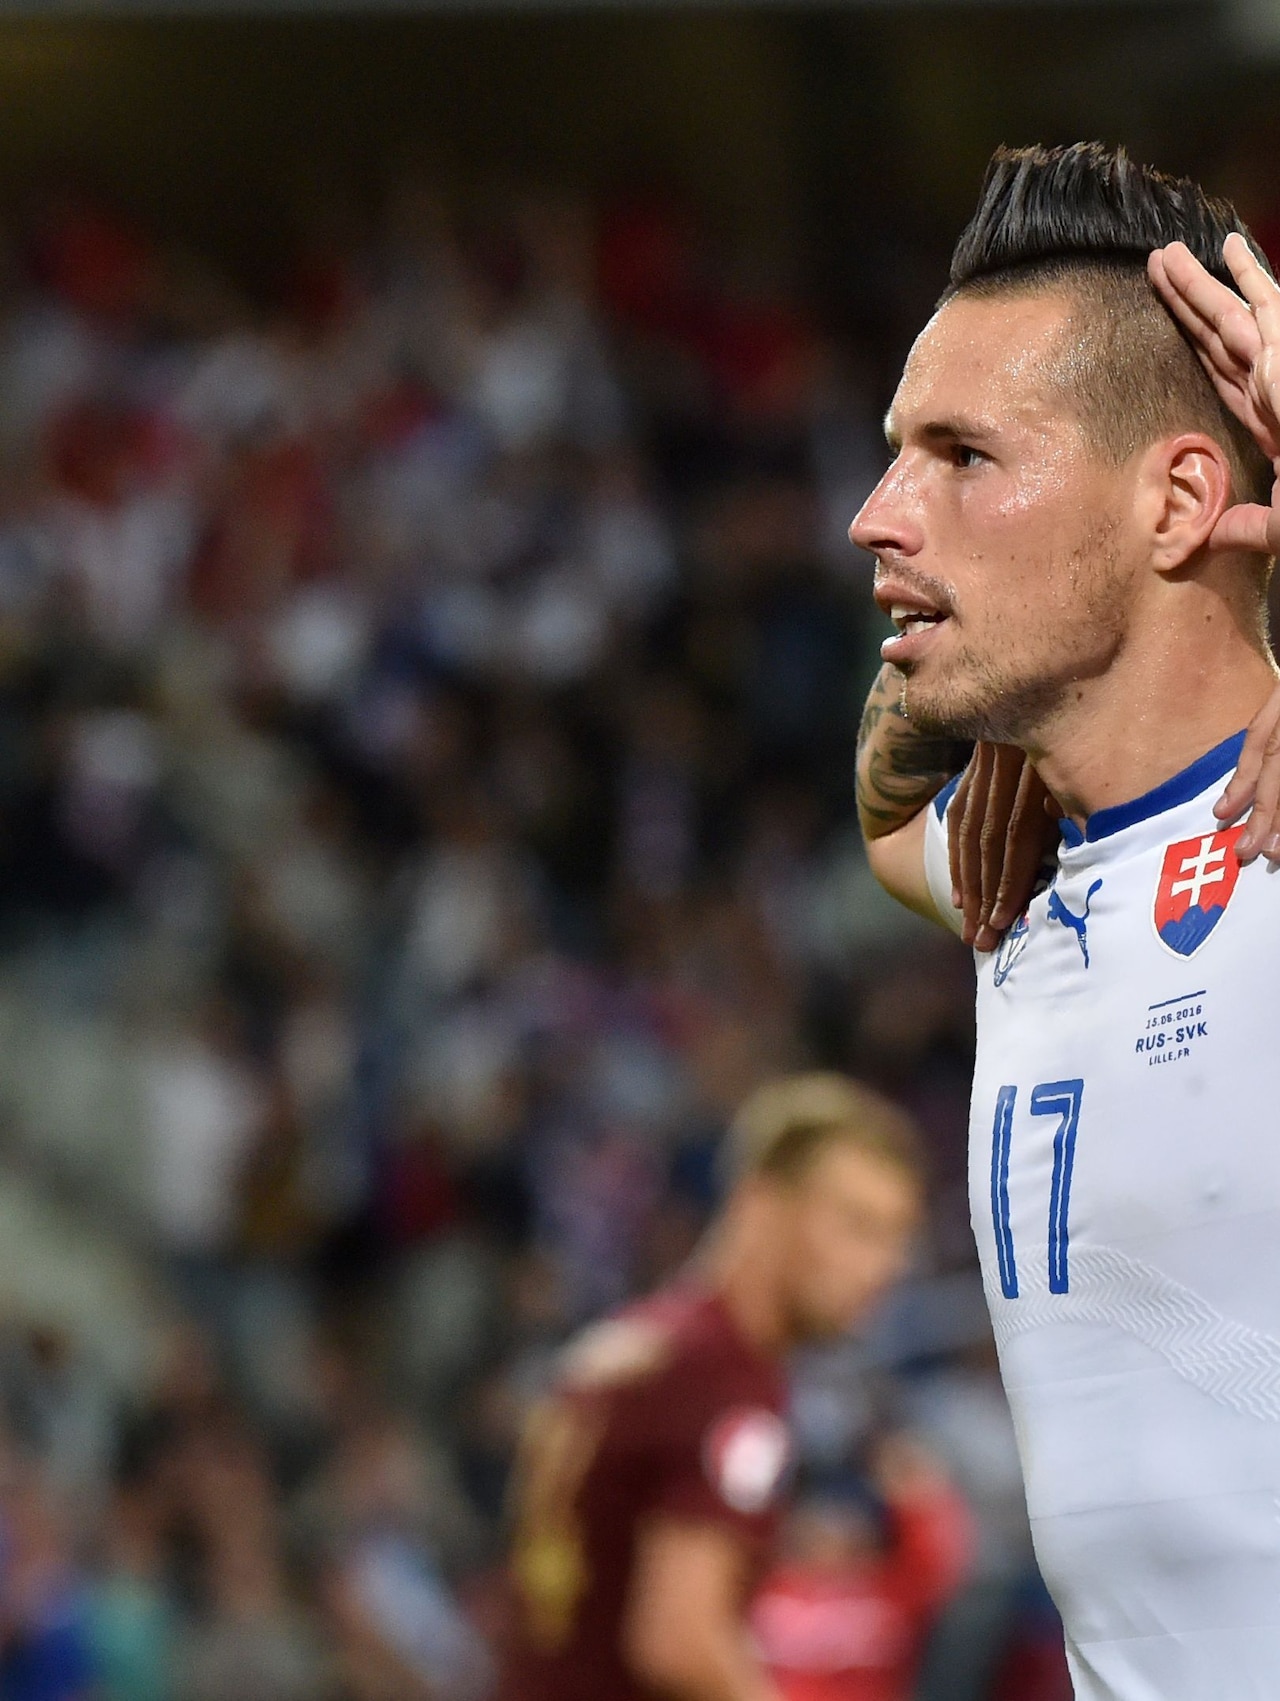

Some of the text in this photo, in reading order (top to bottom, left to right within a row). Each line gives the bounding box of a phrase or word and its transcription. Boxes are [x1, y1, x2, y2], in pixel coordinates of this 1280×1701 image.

[1145, 1004, 1202, 1030] 15.06.2016
[1136, 1021, 1208, 1053] RUS-SVK
[991, 1079, 1084, 1299] 17
